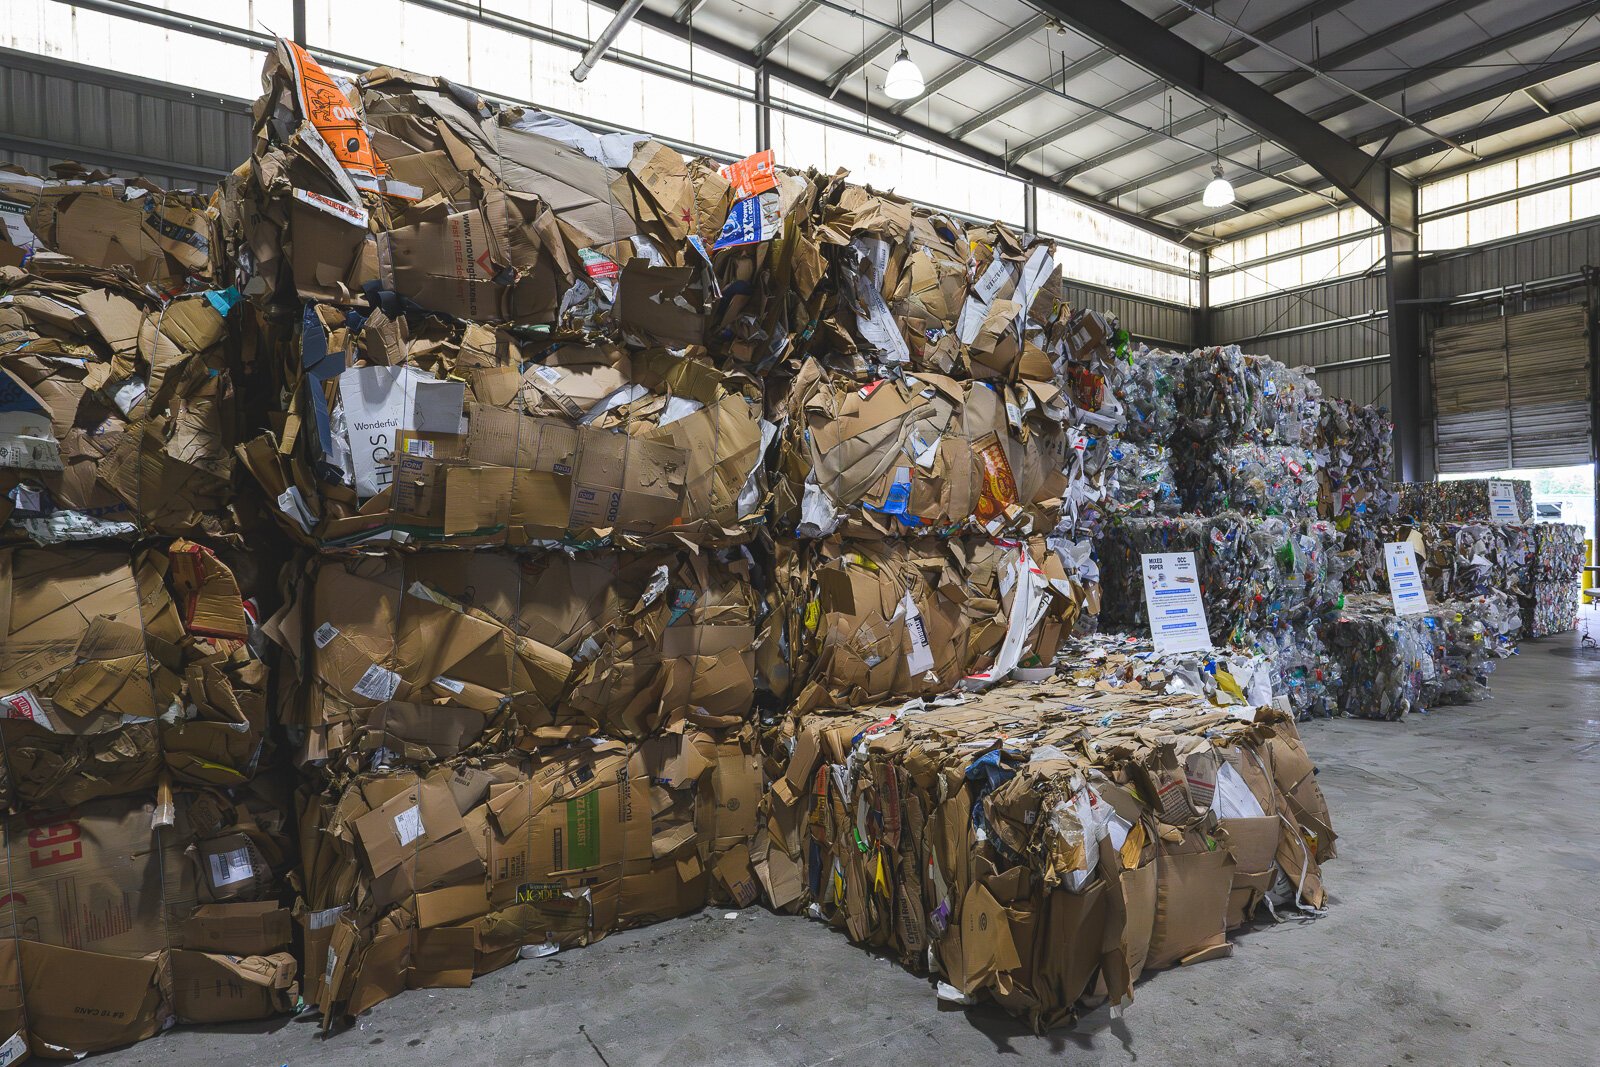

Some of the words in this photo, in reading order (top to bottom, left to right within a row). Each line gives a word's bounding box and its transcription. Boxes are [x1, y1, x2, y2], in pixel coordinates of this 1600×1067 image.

[746, 199, 754, 214] cold
[451, 220, 460, 238] Fast
[743, 221, 755, 241] 3X
[454, 240, 464, 263] FREE
[354, 418, 398, 431] Wonderful
[369, 433, 394, 493] HIOS
[402, 461, 422, 469] TORK
[554, 464, 570, 473] TORK
[577, 817, 587, 847] CRUST
[900, 897, 909, 914] Red
[903, 915, 917, 944] Crystal
[75, 1006, 100, 1016] CANS
